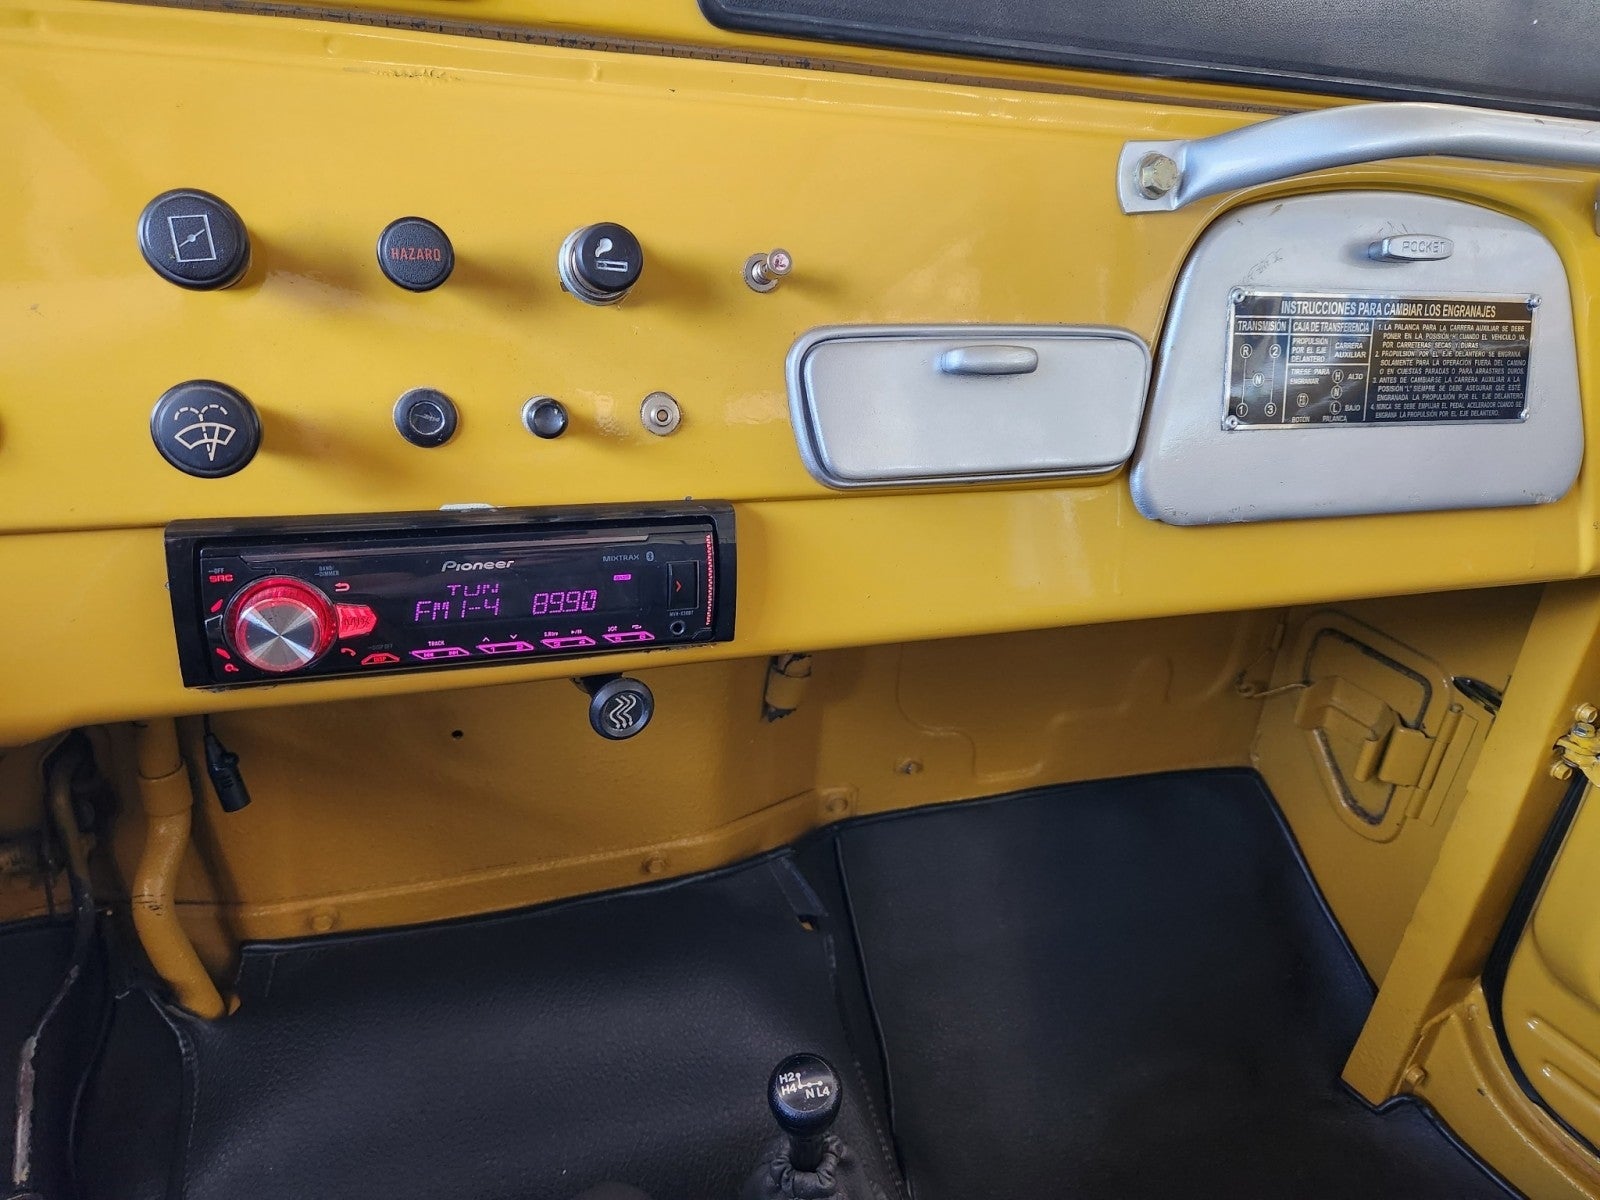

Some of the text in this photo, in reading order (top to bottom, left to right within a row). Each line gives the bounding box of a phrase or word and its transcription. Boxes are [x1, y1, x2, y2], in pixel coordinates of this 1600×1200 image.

[1402, 241, 1447, 253] POCKET
[391, 247, 441, 261] HAZARD
[1281, 300, 1496, 318] INSTRUCCIONES PARA CAMBIAR LOS ENGRANAJES
[1238, 319, 1286, 331] TRANSMISIÓN
[1293, 321, 1369, 332] CAJA DE TRANSFERENCIA
[1384, 323, 1392, 331] LA
[1394, 323, 1420, 331] PALANCA
[1450, 324, 1474, 332] CARRERA
[1383, 332, 1401, 340] PONER
[1404, 332, 1412, 340] EN
[1414, 332, 1423, 340] LA
[1335, 342, 1364, 350] CARRERA
[1382, 341, 1394, 349] POR
[1396, 341, 1431, 349] CARRETERAS
[1434, 341, 1452, 349] SECAS
[1292, 346, 1327, 354] POR EL EJE
[1418, 350, 1430, 358] POR
[1432, 350, 1439, 358] EL
[1441, 350, 1453, 358] EJE
[1454, 350, 1486, 358] DELANTERO
[1291, 355, 1326, 363] DELANTERO
[1334, 351, 1367, 359] AUXILIAR
[1380, 359, 1414, 367] SOLAMENTE
[1415, 359, 1430, 367] PARA
[1432, 359, 1440, 367] LA
[1474, 359, 1492, 367] FUERA
[1493, 359, 1504, 367] DEL
[1506, 359, 1526, 367] CAMINO
[1387, 367, 1395, 375] EN
[1396, 367, 1422, 375] CUESTAS
[1424, 367, 1450, 375] PARADAS
[1458, 367, 1473, 375] PARA
[1475, 367, 1505, 375] ARRASTRES
[1379, 376, 1397, 384] ANTES
[1400, 376, 1408, 384] DE
[1410, 376, 1442, 384] CAMBIARSE
[1444, 376, 1452, 384] LA
[1454, 376, 1478, 384] CARRERA
[1480, 376, 1506, 384] AUXILIAR
[1512, 376, 1520, 384] LA
[1465, 384, 1493, 392] ASEGURAR
[1344, 404, 1361, 412] BAJO
[1394, 403, 1402, 411] SE
[1403, 403, 1416, 411] DEBE
[1441, 402, 1449, 410] EL
[1466, 401, 1497, 409] ACELERADOR
[441, 559, 515, 572] Pioneer
[209, 574, 234, 583] SRC
[446, 583, 500, 597] TUN
[779, 1072, 796, 1084] H2
[781, 1083, 797, 1096] H4
[805, 1086, 830, 1099] N L4
